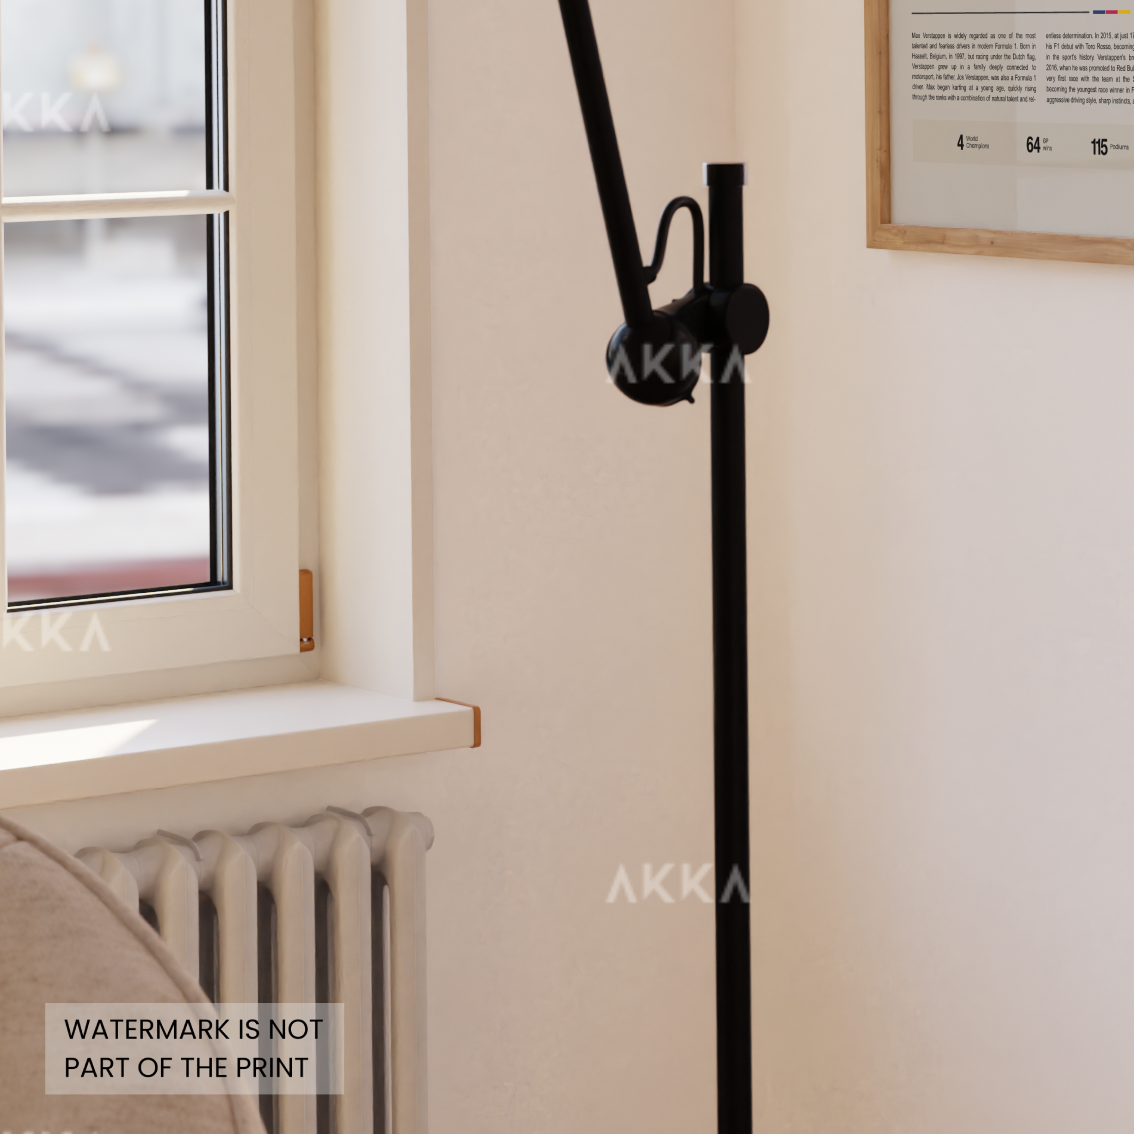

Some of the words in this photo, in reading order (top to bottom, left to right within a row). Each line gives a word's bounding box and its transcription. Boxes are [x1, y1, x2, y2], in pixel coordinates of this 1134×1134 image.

[957, 134, 965, 150] 4
[1026, 136, 1041, 153] 64
[1090, 138, 1108, 155] 115
